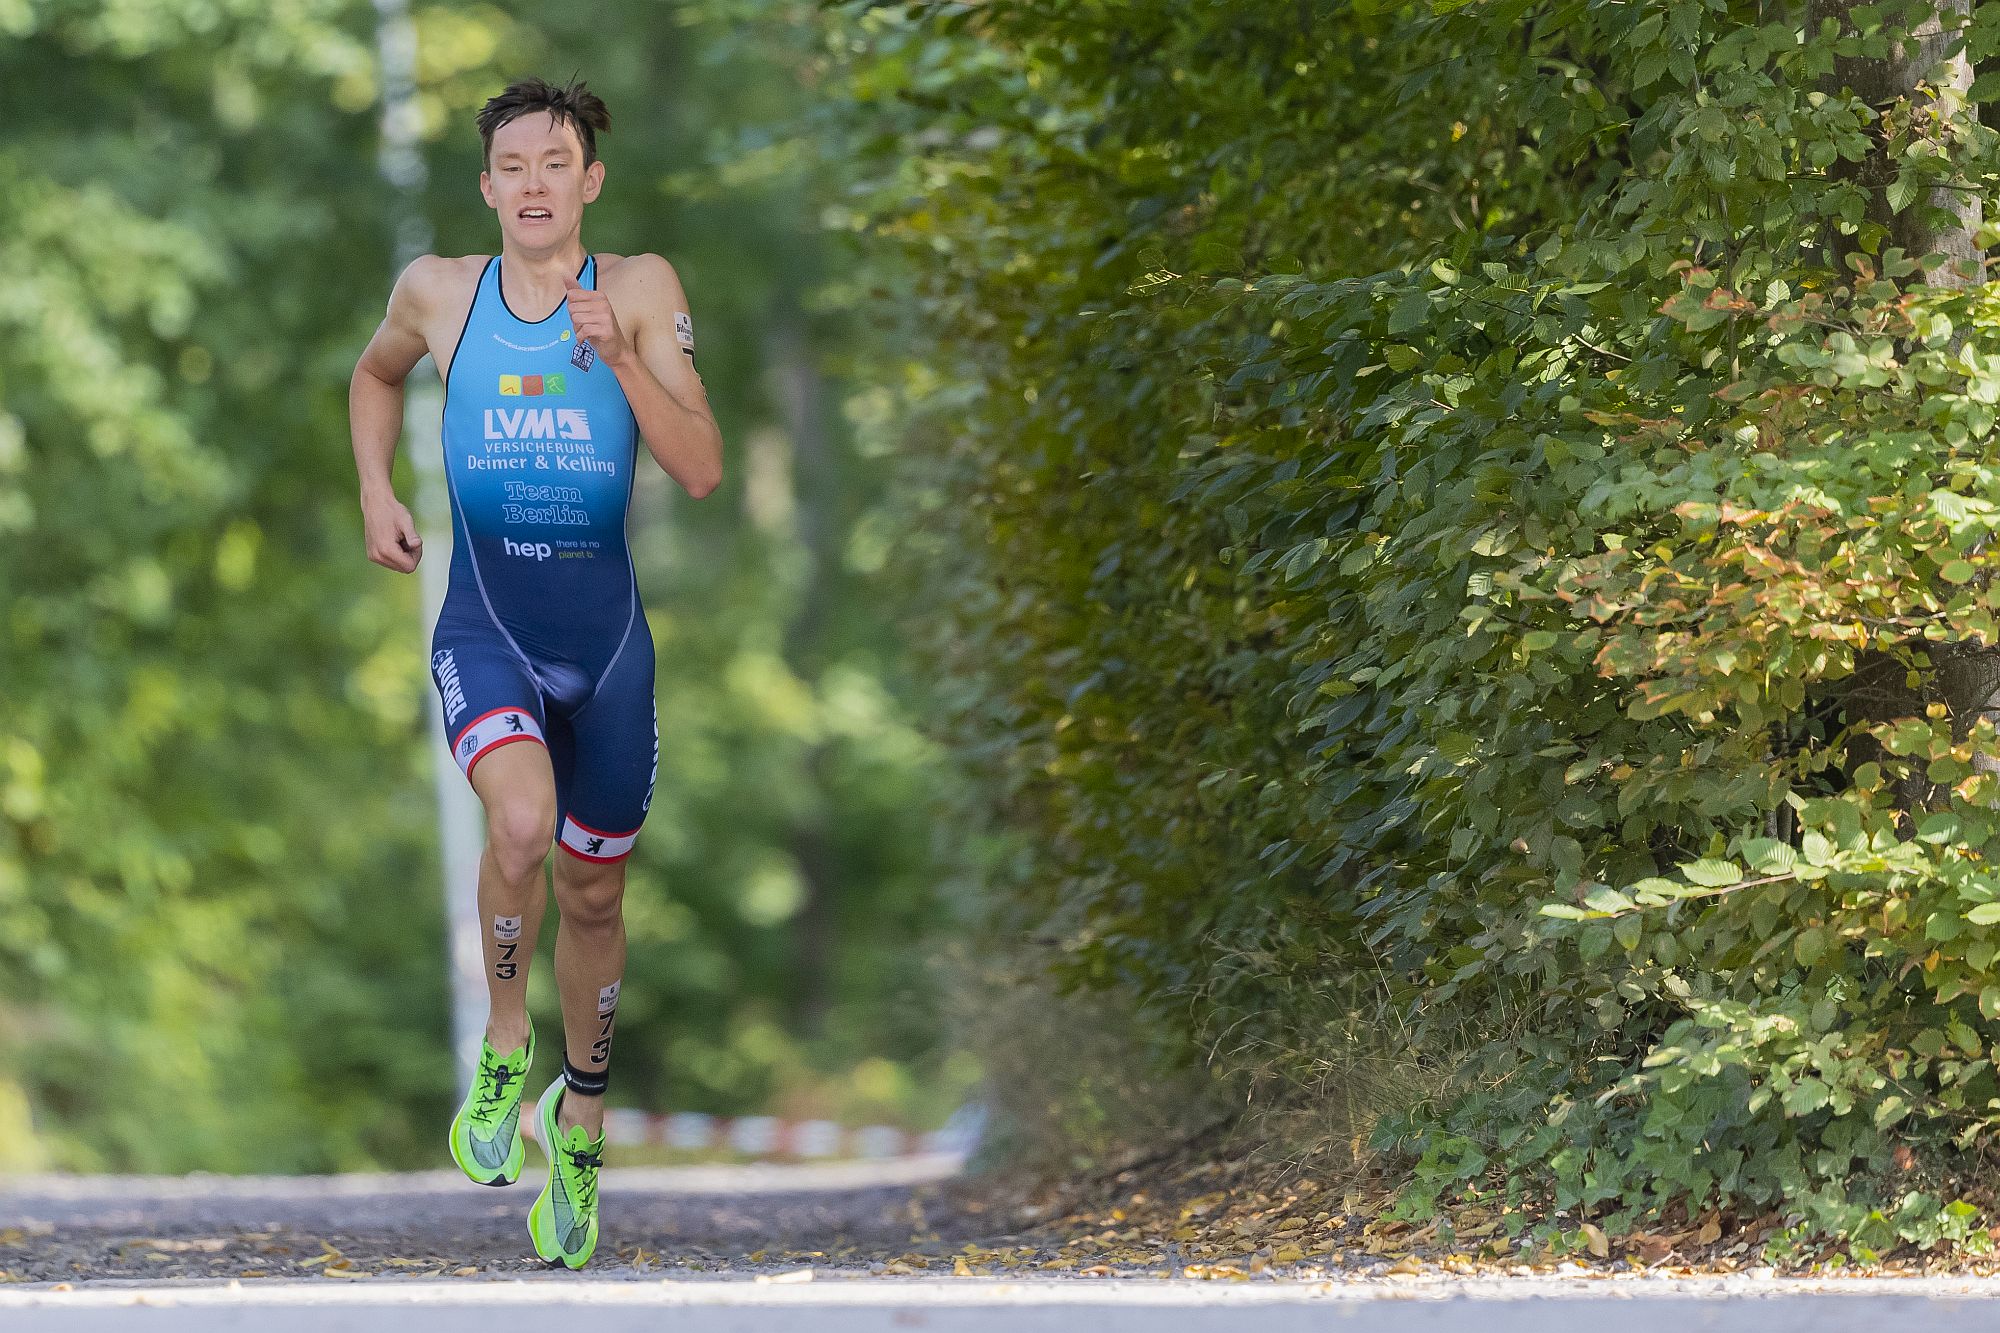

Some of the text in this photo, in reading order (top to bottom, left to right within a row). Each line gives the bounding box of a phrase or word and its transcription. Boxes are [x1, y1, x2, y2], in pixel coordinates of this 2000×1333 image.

[484, 408, 556, 440] LVM
[484, 442, 595, 454] VERSICHERUNG
[467, 455, 615, 476] Deimer & Kelling
[504, 481, 583, 503] Team
[502, 503, 590, 525] Berlin
[503, 537, 551, 562] hep
[556, 539, 578, 548] there
[579, 539, 587, 548] is
[559, 550, 585, 560] planet
